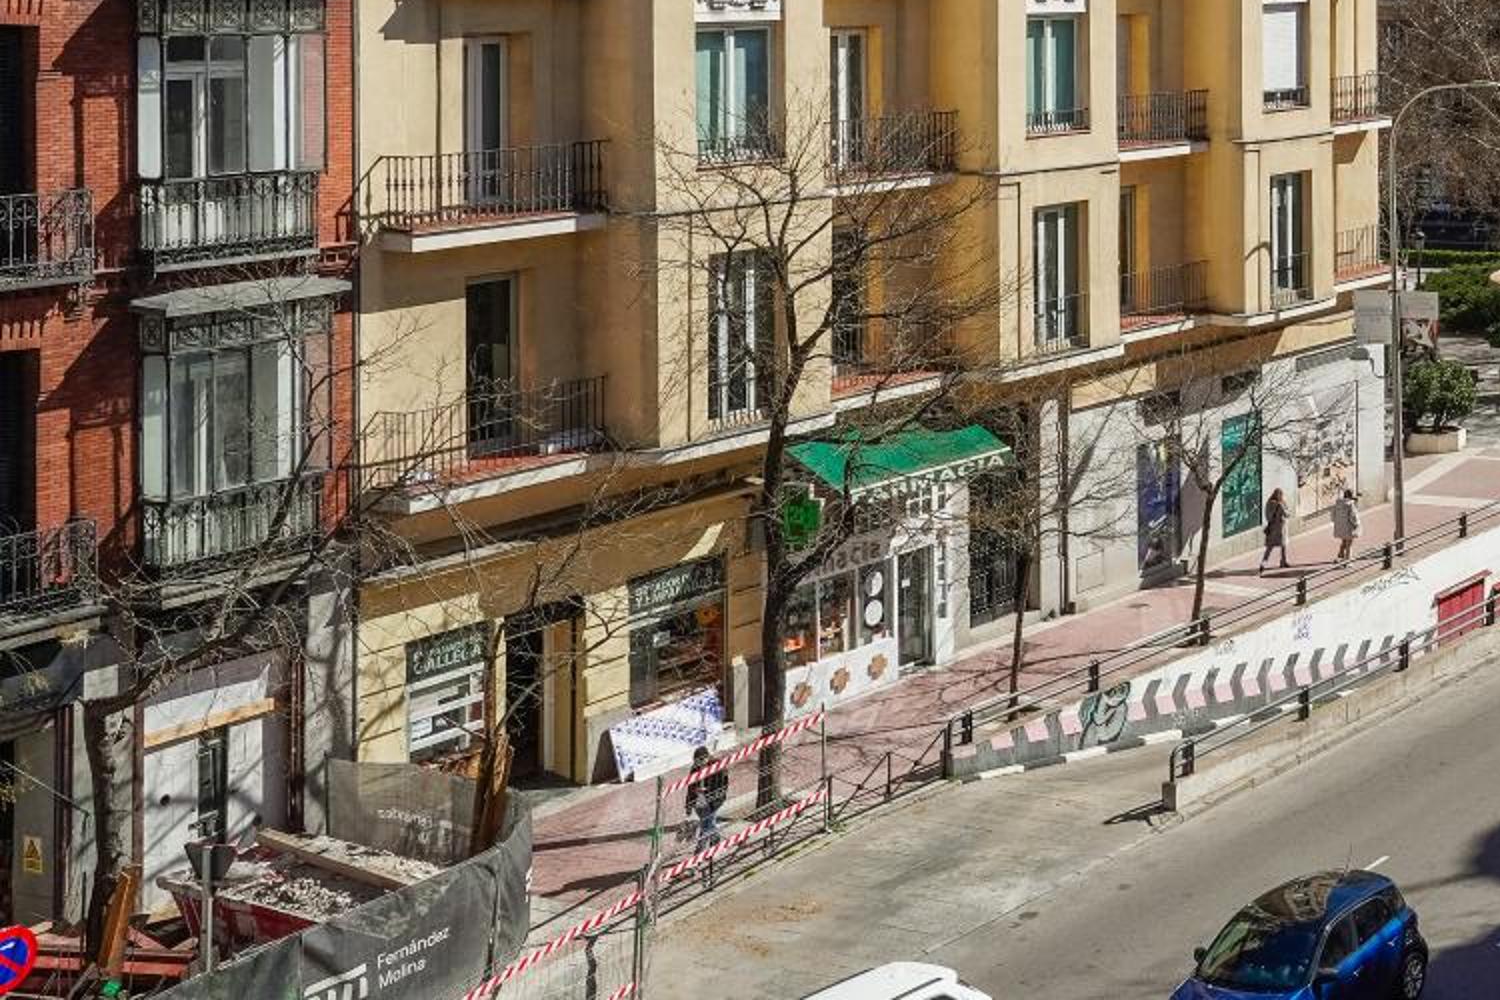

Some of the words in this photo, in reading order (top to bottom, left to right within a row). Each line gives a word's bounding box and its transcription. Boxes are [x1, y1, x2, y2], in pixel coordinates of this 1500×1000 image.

[851, 456, 1004, 504] FARMACIA
[377, 927, 450, 969] Fernández
[378, 958, 427, 989] Molina
